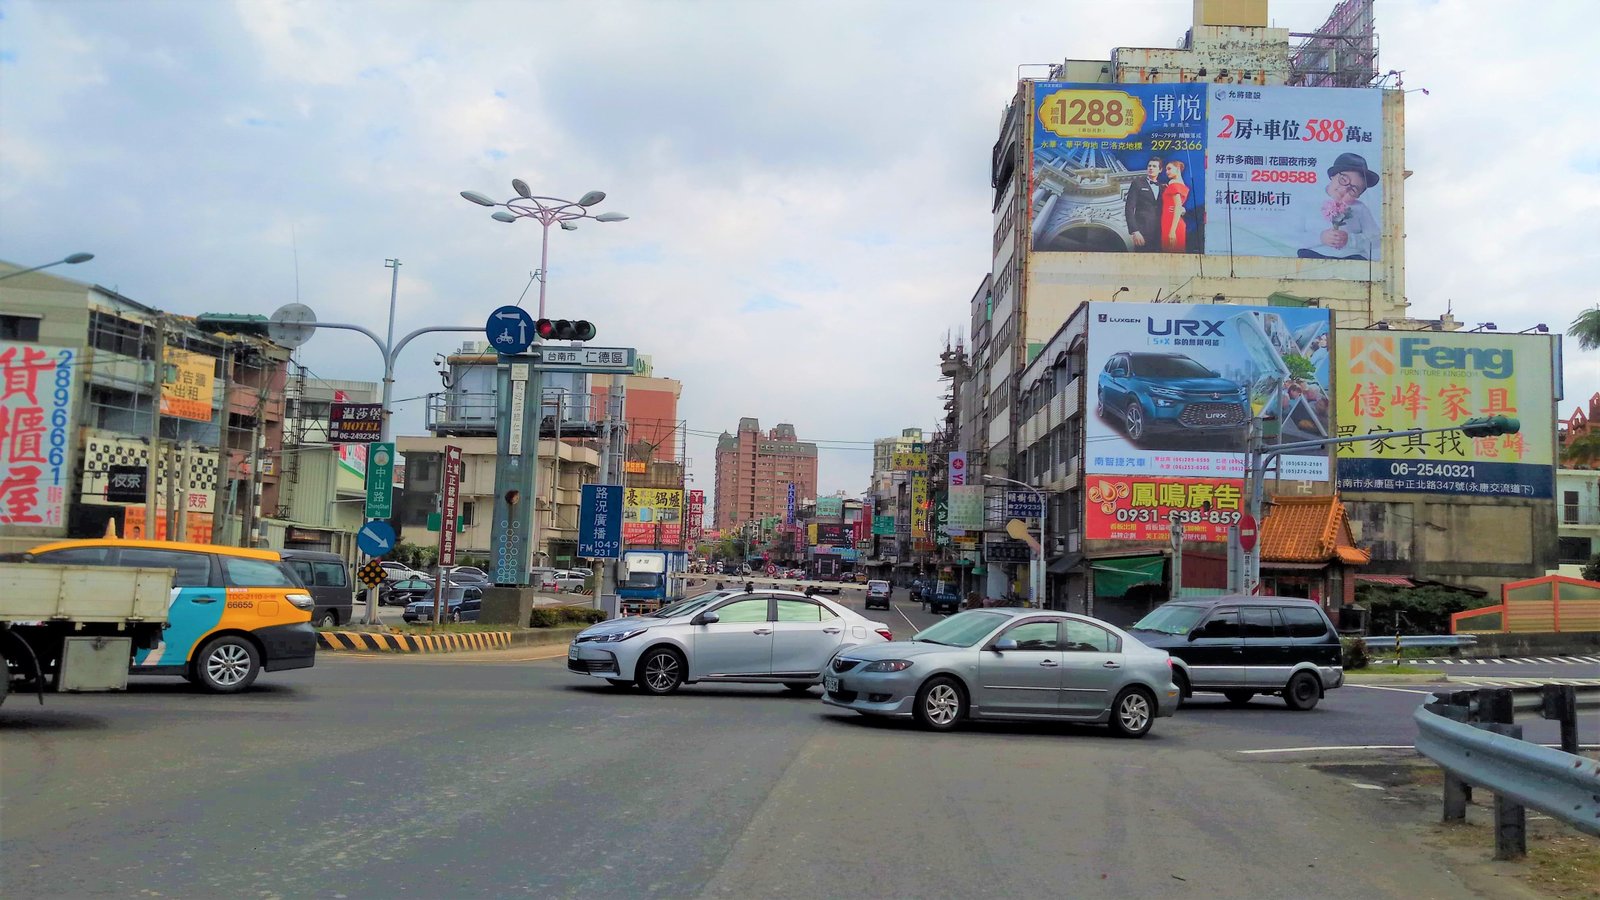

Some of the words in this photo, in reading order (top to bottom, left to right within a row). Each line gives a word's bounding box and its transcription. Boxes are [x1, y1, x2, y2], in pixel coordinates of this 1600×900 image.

[1056, 99, 1123, 126] 1288
[1217, 114, 1372, 143] 2房+車位588萬起
[1151, 140, 1202, 150] 297-3366
[1250, 169, 1318, 184] 2509588
[1148, 316, 1225, 337] URX
[548, 352, 576, 361] 台南市
[586, 351, 622, 363] 仁德區
[1400, 338, 1514, 379] Feng
[174, 385, 198, 401] 出租
[1349, 382, 1517, 421] 億峰家具
[49, 350, 73, 485] 2896661
[341, 421, 380, 431] MOTEL
[1390, 462, 1475, 478] 06-2540321
[373, 467, 386, 502] 中山路
[1131, 483, 1241, 509] 鳳鳴廣告
[593, 487, 608, 540] 路況廣播
[580, 544, 593, 552] FM
[594, 549, 610, 557] 93.1
[595, 541, 618, 549] 104.9
[227, 601, 253, 609] 66655
